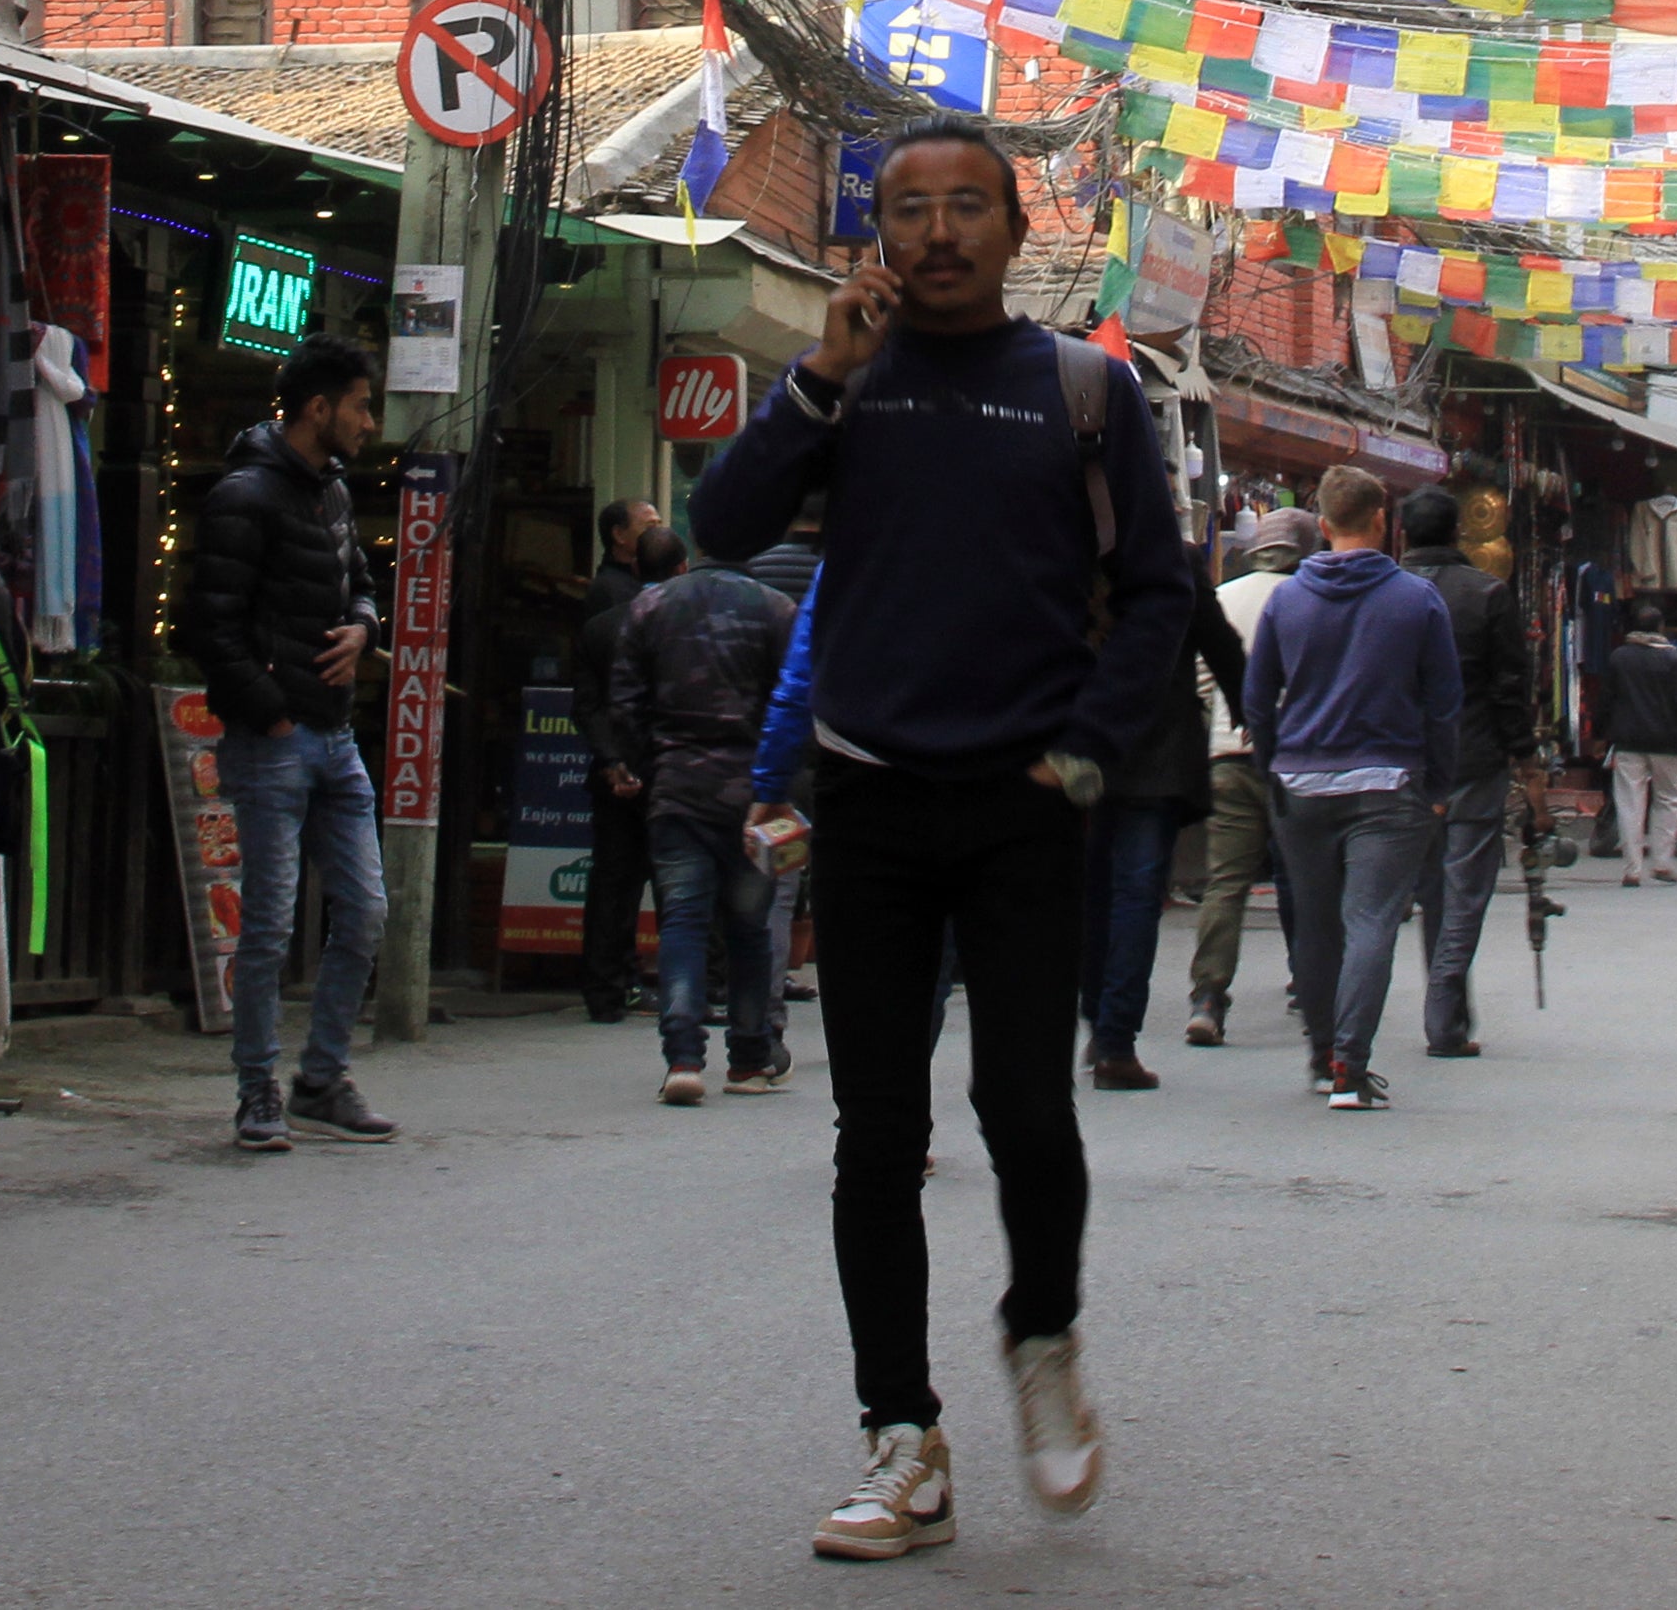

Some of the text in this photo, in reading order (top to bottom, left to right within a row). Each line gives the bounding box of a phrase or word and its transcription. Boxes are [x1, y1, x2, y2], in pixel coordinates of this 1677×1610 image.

[436, 16, 515, 112] P
[842, 173, 873, 198] Re
[665, 368, 733, 431] illy
[406, 491, 436, 633] HOTEL
[393, 646, 430, 816] MANDAP
[548, 751, 587, 765] serve
[520, 806, 563, 827] Enjoy
